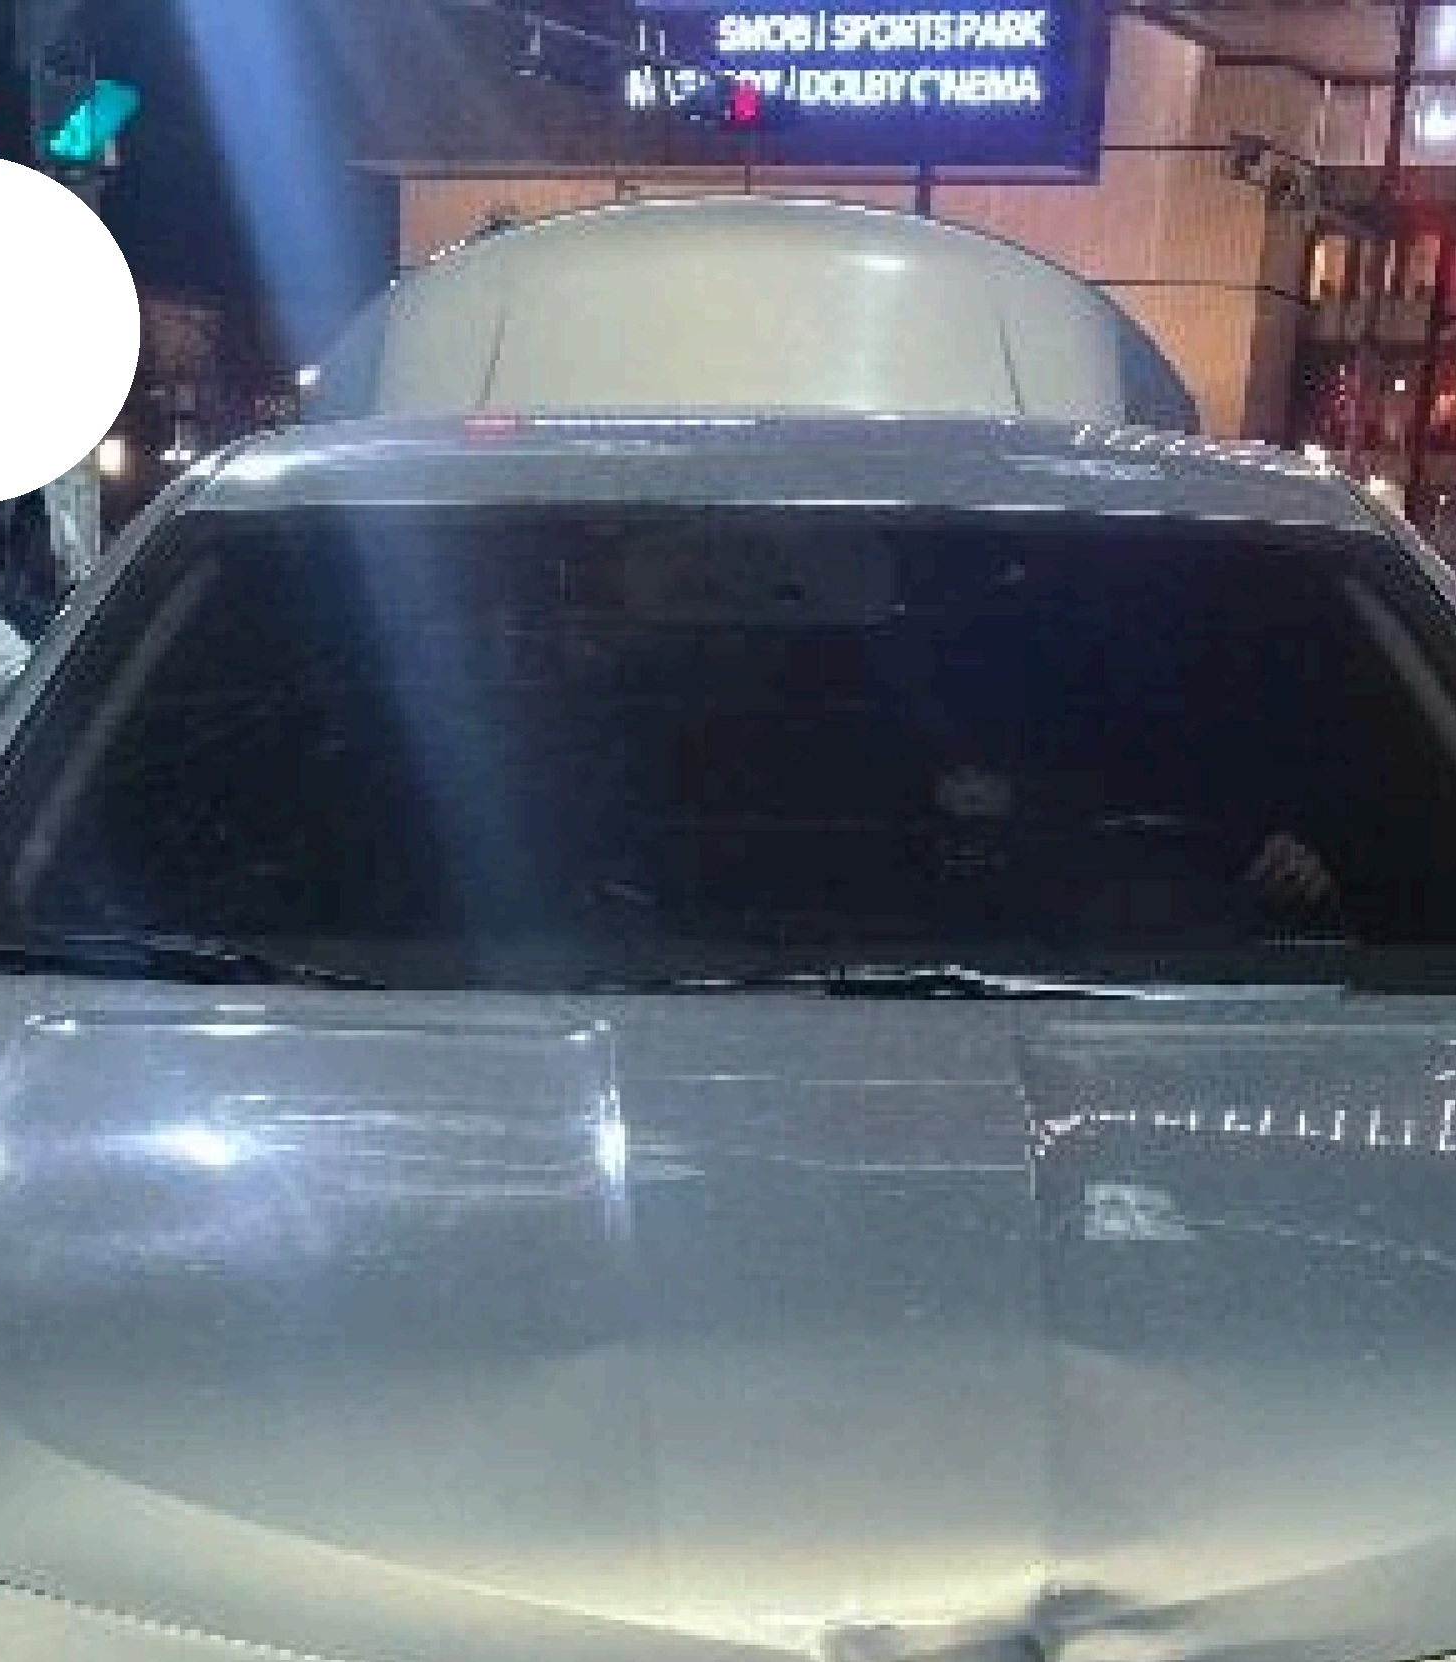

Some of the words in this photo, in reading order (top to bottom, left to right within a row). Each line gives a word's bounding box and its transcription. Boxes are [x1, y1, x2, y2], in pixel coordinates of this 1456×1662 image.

[830, 11, 951, 51] SPORTS
[958, 9, 1046, 47] PARK
[799, 69, 910, 106] DOLBY
